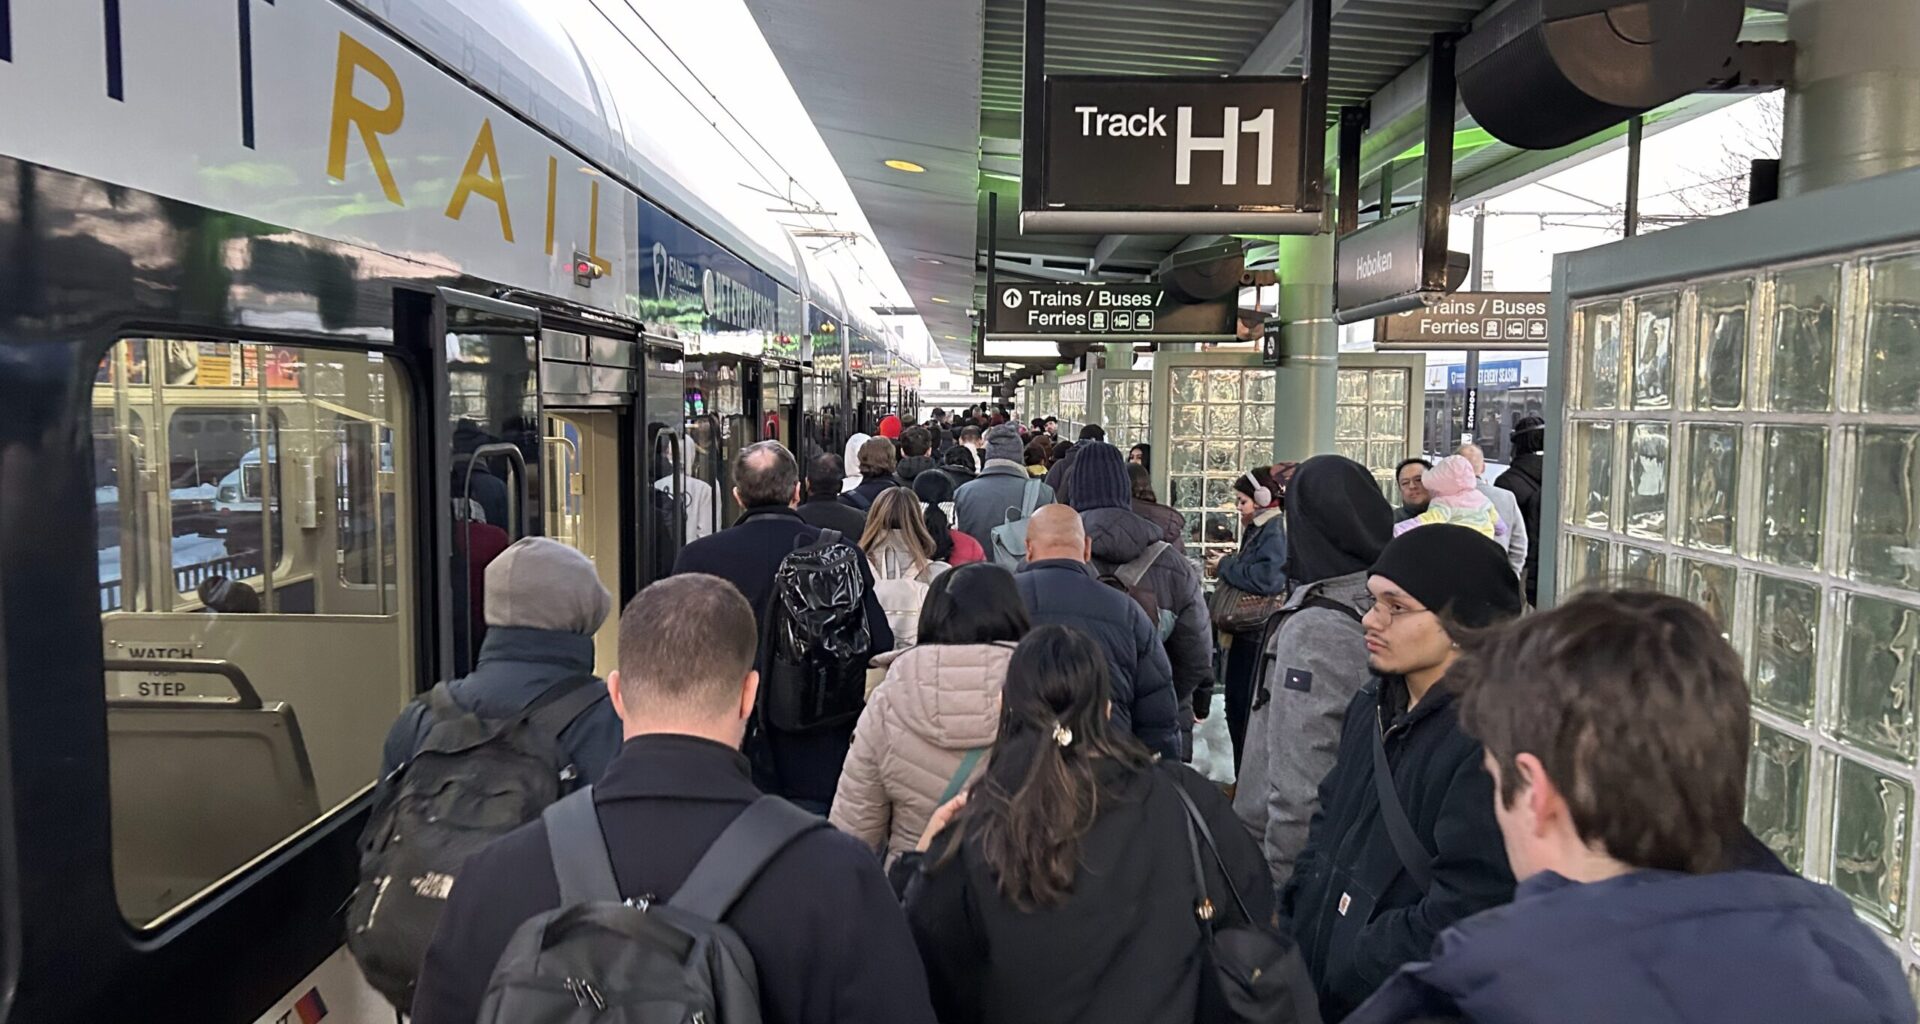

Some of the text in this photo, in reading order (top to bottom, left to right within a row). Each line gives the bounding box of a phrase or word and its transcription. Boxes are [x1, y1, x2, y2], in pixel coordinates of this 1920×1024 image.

[1074, 106, 1274, 185] Track H1
[327, 31, 611, 276] RAIL
[1356, 251, 1393, 280] Hoboken
[1029, 290, 1082, 306] Trains
[1086, 290, 1094, 307] /
[1100, 291, 1151, 306] Buses
[1492, 300, 1546, 314] Buses
[1028, 310, 1086, 326] Ferries
[1420, 319, 1479, 334] Ferries
[988, 373, 999, 382] H1
[129, 648, 193, 658] WATCH
[138, 682, 186, 696] STEP
